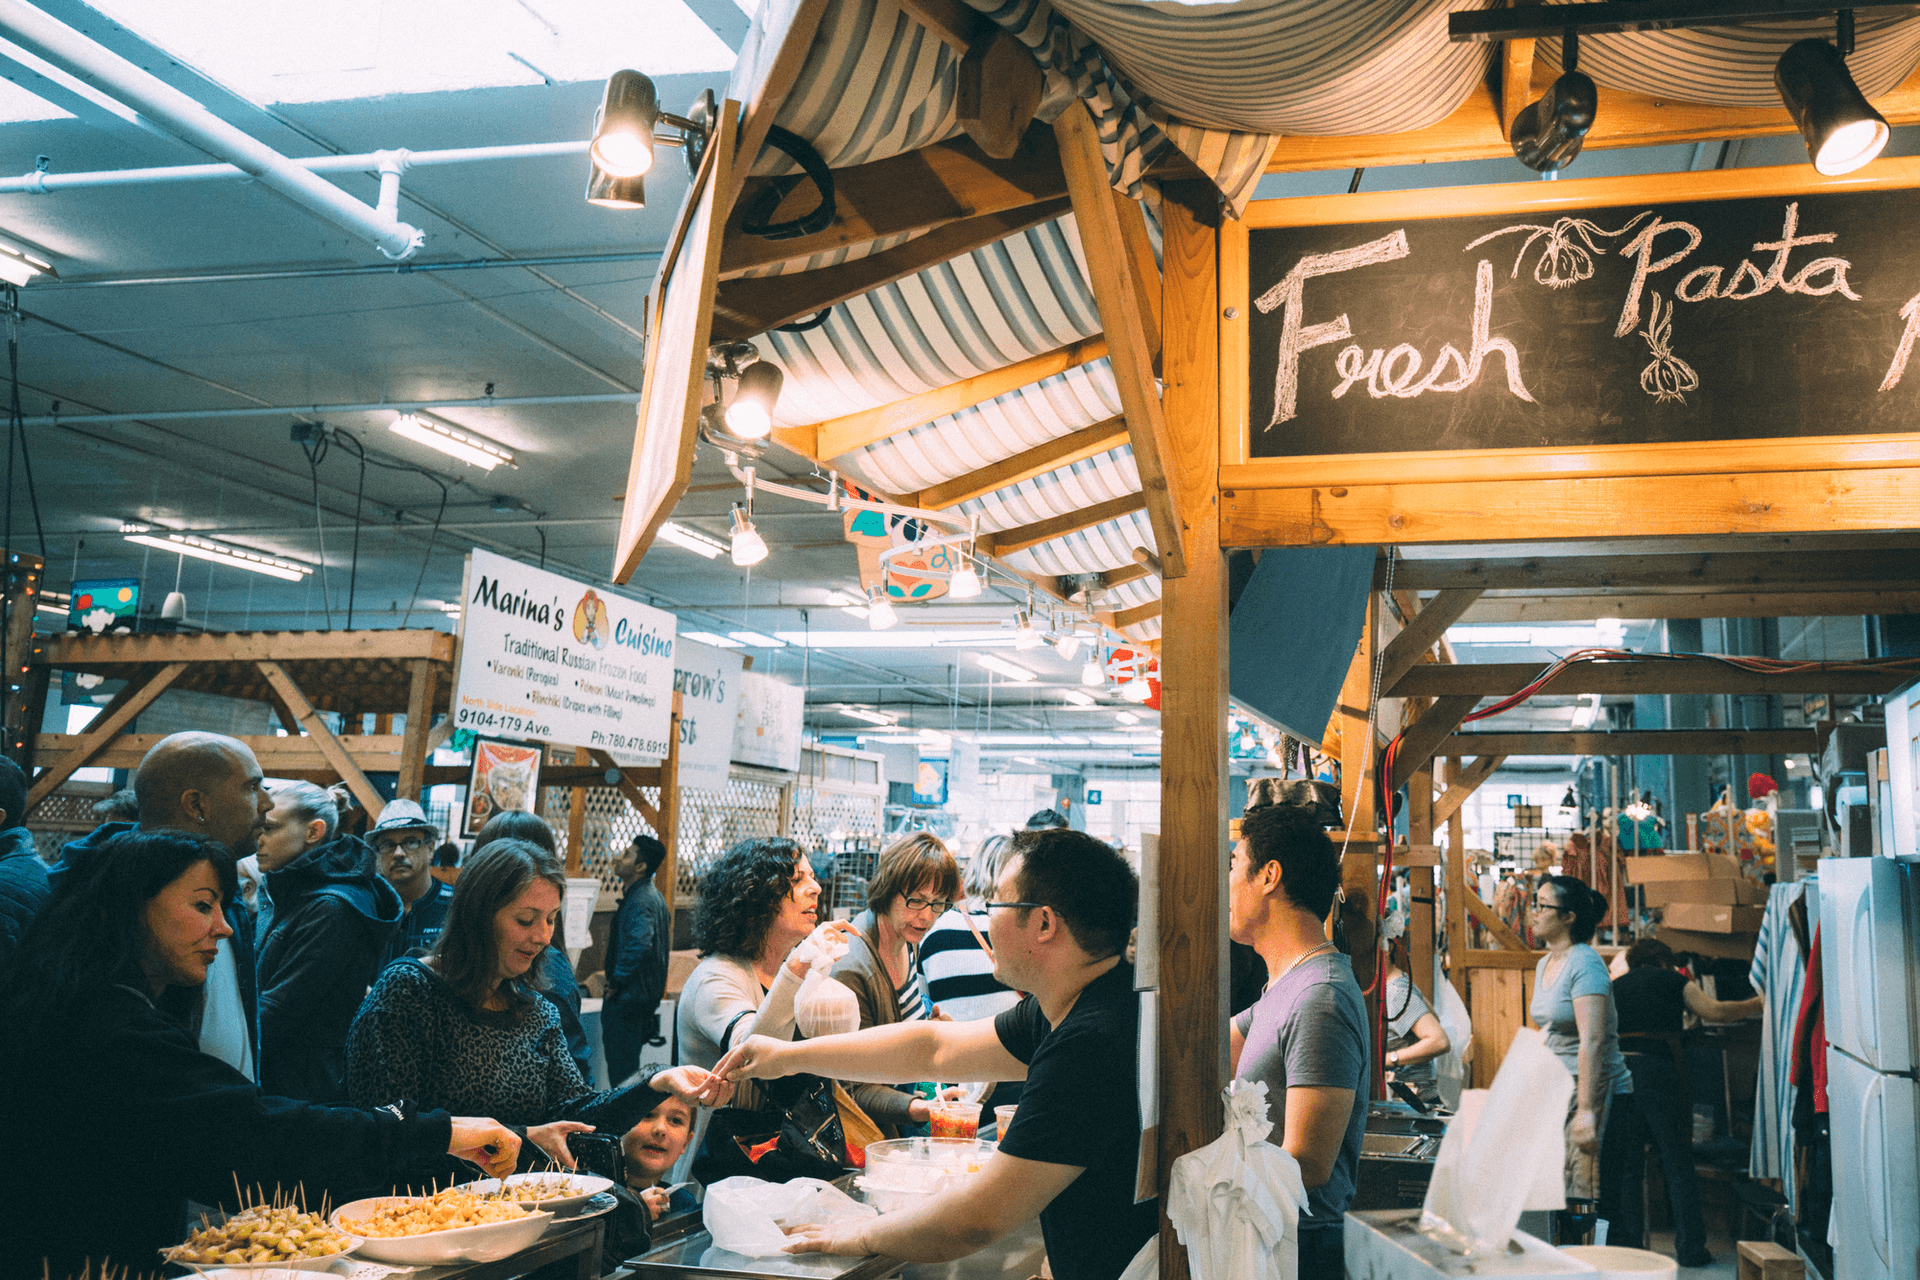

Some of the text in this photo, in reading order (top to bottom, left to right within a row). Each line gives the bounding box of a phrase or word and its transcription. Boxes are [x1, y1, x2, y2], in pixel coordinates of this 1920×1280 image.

[1254, 202, 1862, 433] Fresh Pasta
[472, 575, 673, 658] Marina's Cuisine
[504, 633, 648, 685] Traditional Russian Frozen Food
[462, 695, 536, 717] North Side Location
[587, 702, 602, 716] with
[459, 708, 668, 756] 9104-179 Ave. Ph:780.478.6915
[1089, 791, 1100, 803] 4
